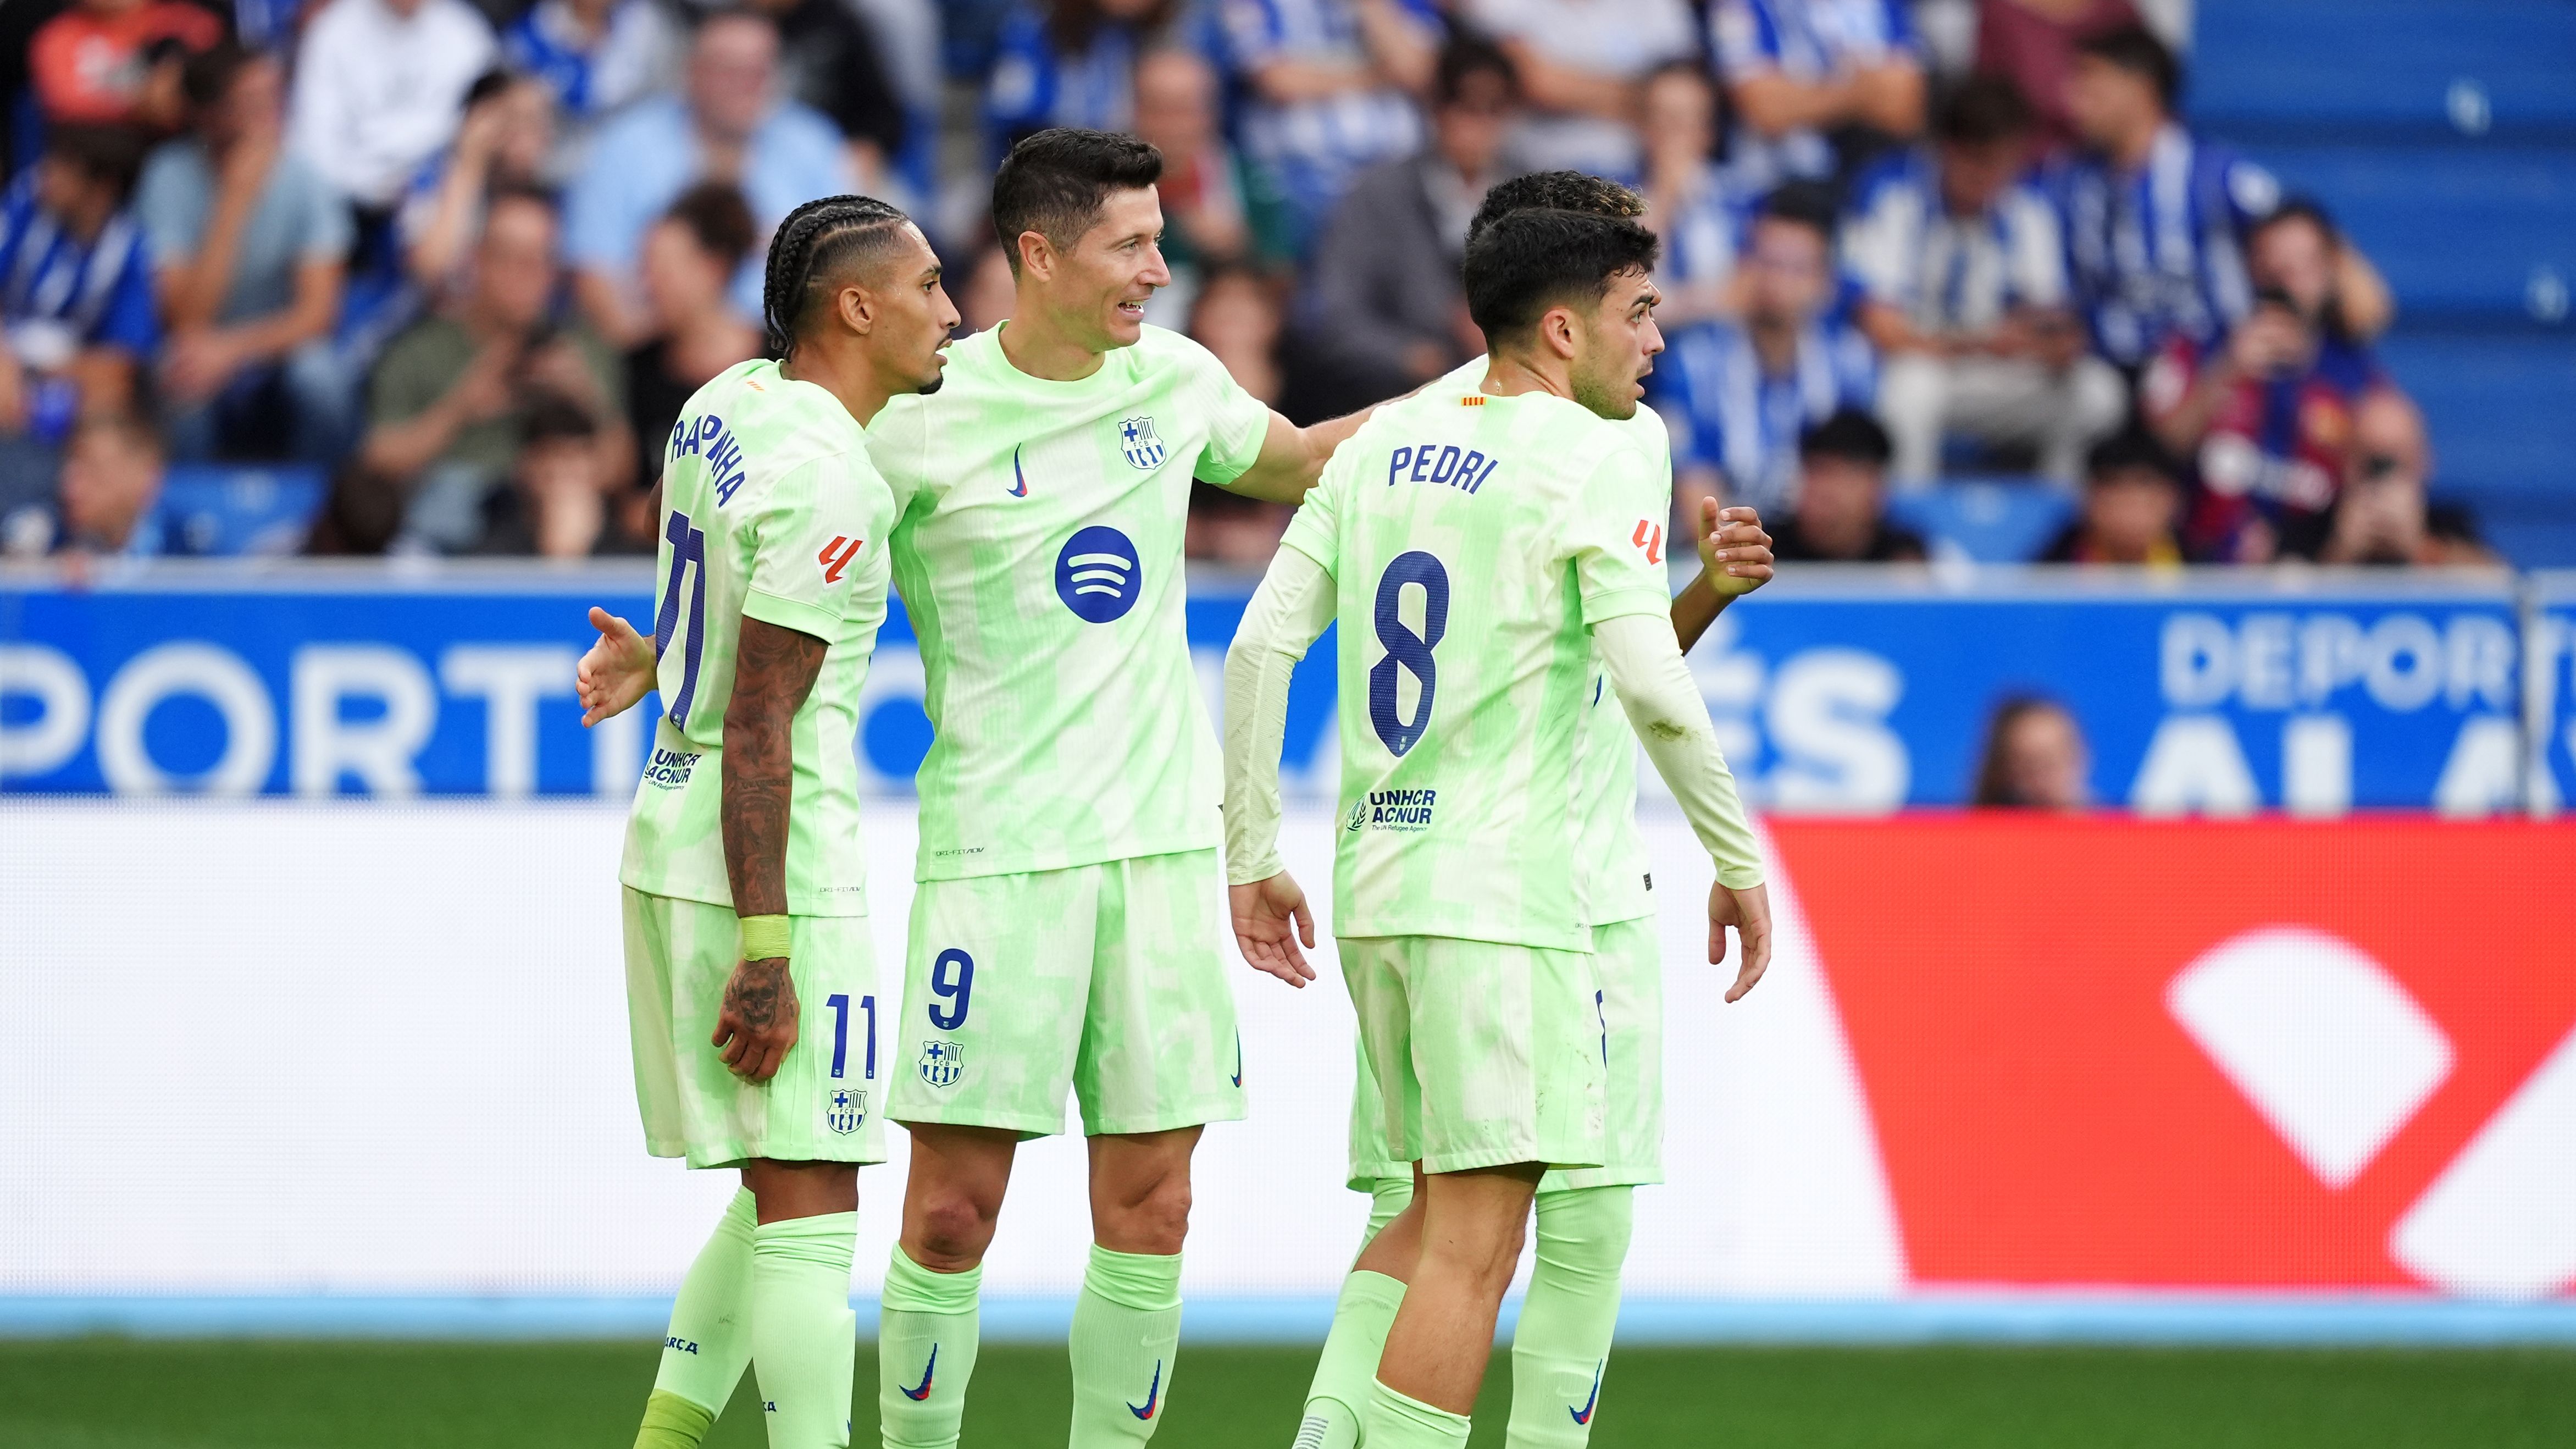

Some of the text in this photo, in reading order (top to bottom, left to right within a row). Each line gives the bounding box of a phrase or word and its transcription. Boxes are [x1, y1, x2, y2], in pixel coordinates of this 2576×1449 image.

[1133, 440, 1149, 449] FCB
[1388, 445, 1499, 495] PEDRI
[1369, 551, 1449, 758] 8
[655, 748, 702, 767] UNHCR
[648, 766, 691, 783] ACNUR
[1370, 790, 1436, 806] UNHCR
[1372, 807, 1432, 823] ACNUR
[929, 948, 974, 1030] 9
[826, 994, 876, 1079] 11
